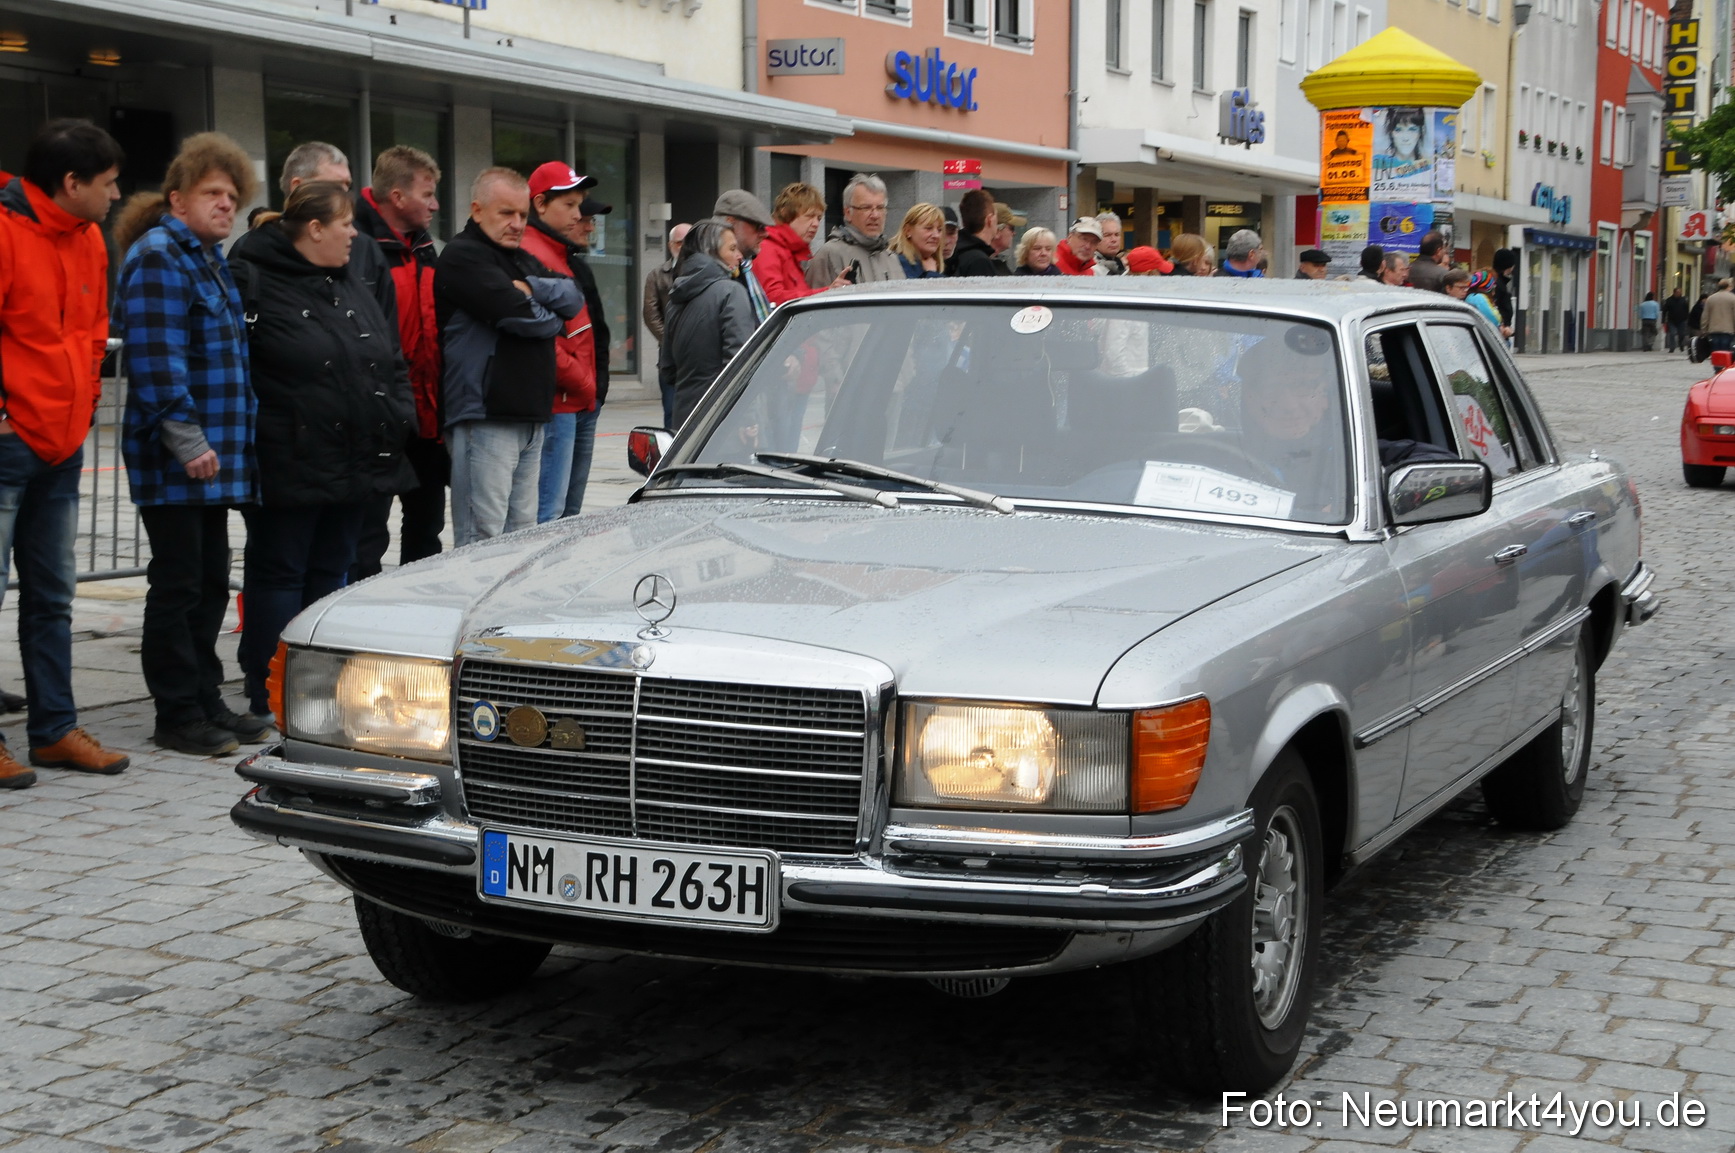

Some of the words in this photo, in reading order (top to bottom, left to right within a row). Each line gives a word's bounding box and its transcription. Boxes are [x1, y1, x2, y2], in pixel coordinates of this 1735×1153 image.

[768, 44, 837, 68] sutor.
[892, 47, 979, 112] sutor.
[1665, 21, 1698, 172] HOTEL
[1326, 159, 1363, 169] Samstag
[1207, 203, 1243, 215] FRIES
[1208, 485, 1259, 507] 493
[489, 869, 500, 885] D
[507, 841, 555, 896] NM
[585, 851, 638, 905] RH
[650, 858, 765, 917] 263H
